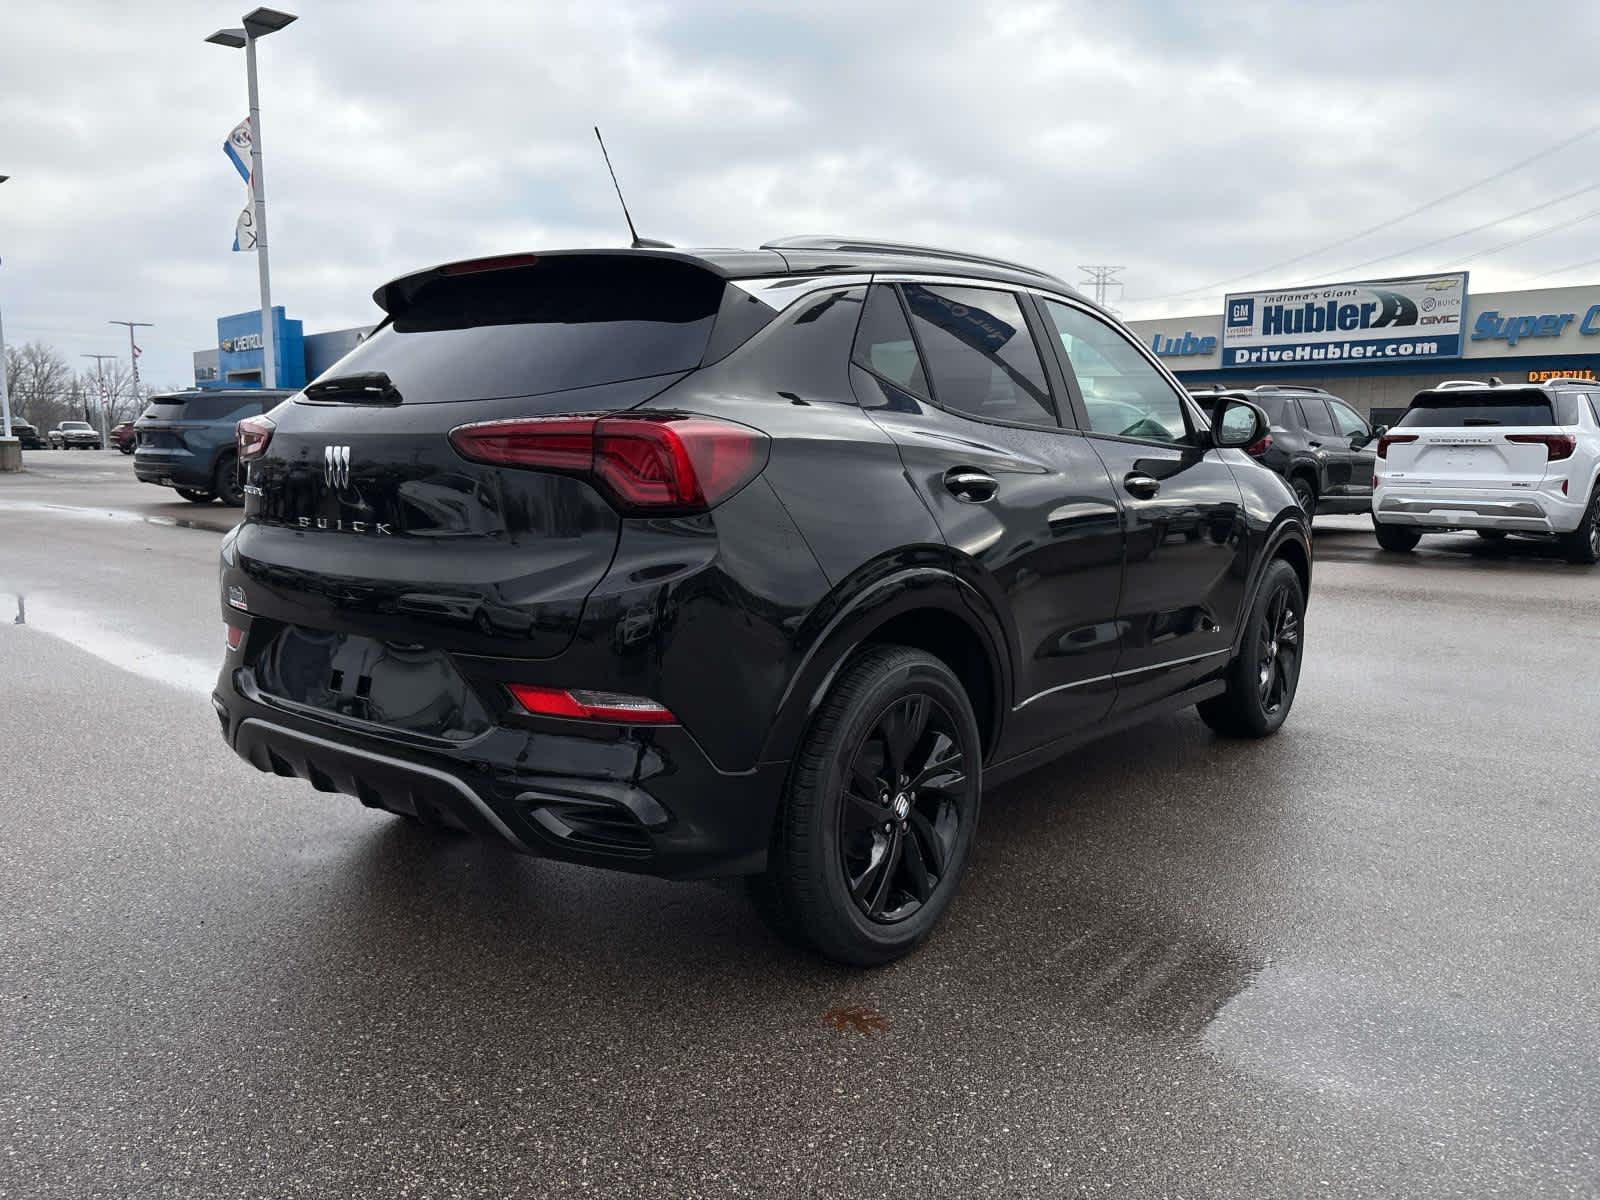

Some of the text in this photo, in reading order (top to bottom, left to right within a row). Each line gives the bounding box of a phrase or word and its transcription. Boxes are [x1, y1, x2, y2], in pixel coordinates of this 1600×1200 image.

[1264, 289, 1358, 303] Indiana's Giant
[1436, 298, 1461, 306] BUICK
[1233, 304, 1249, 318] GM
[1262, 300, 1377, 336] Hubler
[1420, 314, 1459, 325] GMC
[1471, 311, 1576, 346] Super
[1151, 330, 1217, 357] Lube
[1235, 342, 1438, 363] DriveHubler.com
[298, 516, 392, 535] BUICK
